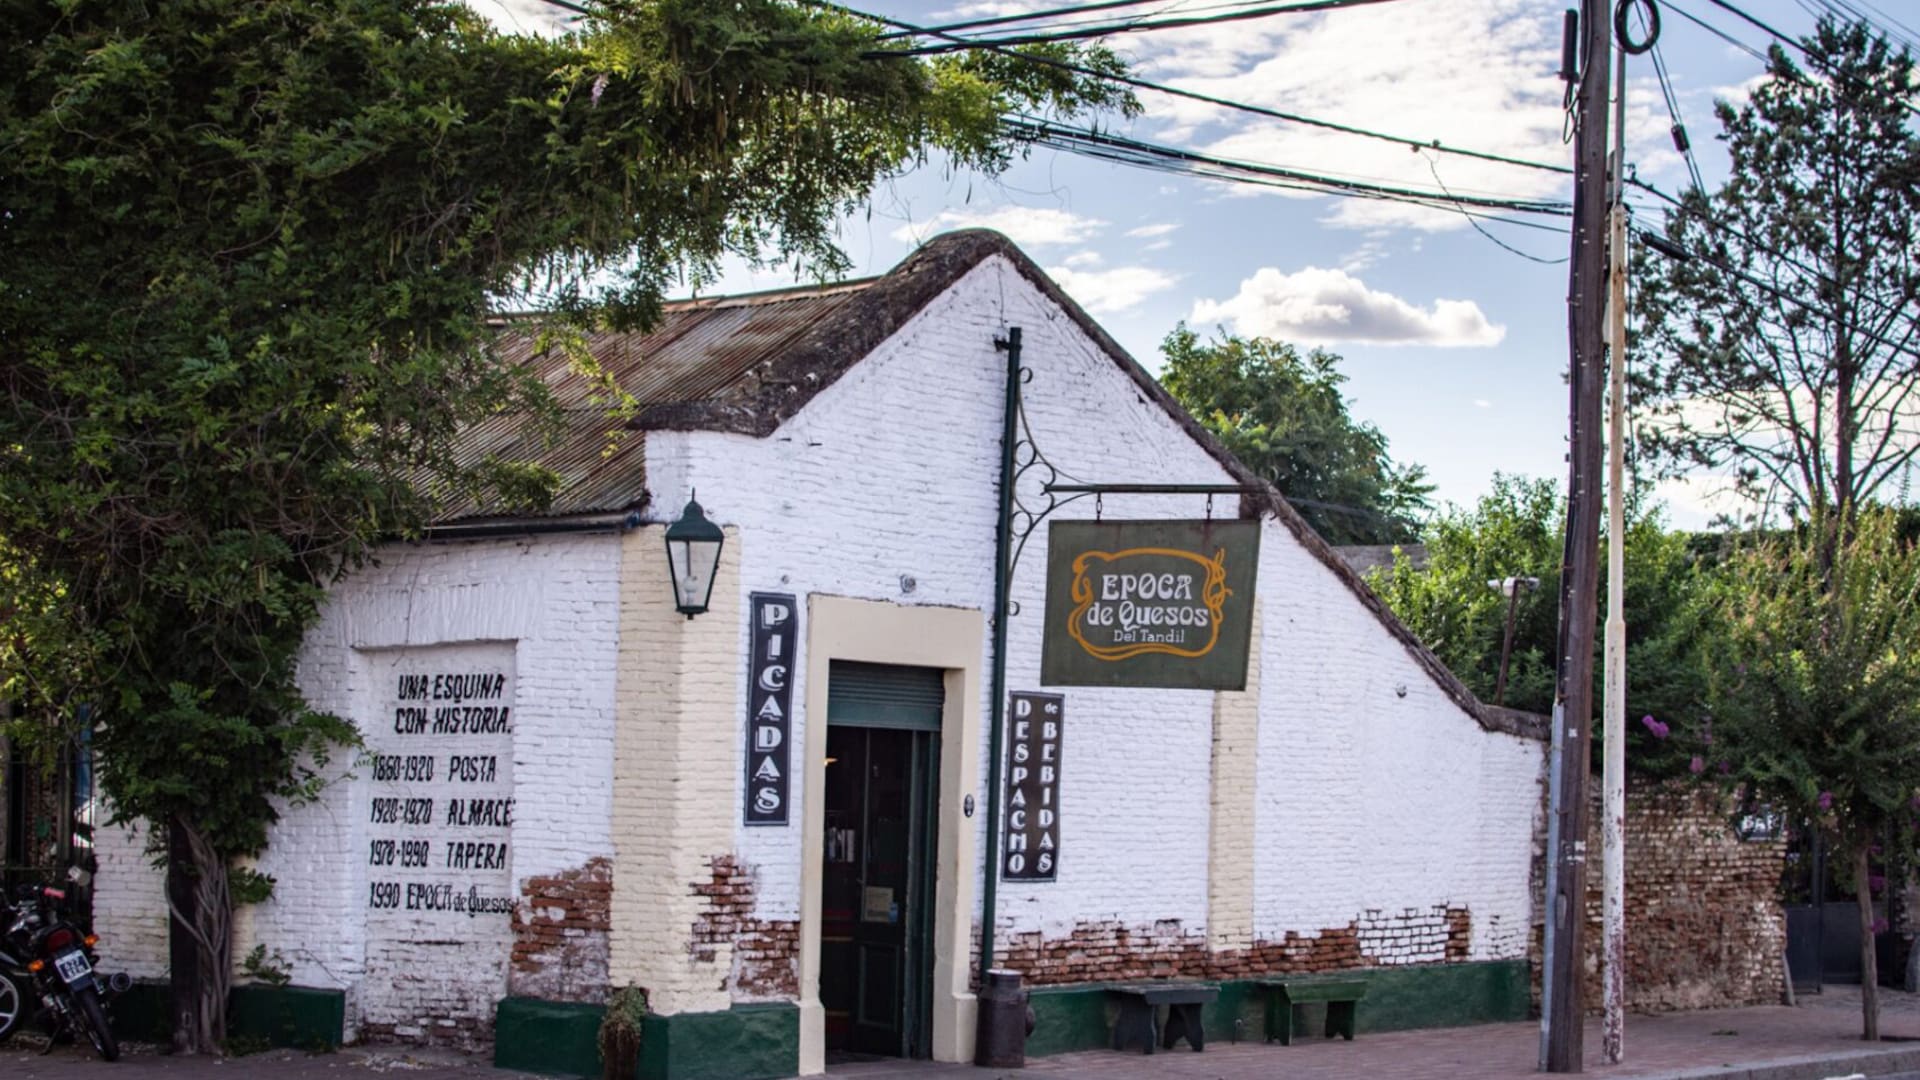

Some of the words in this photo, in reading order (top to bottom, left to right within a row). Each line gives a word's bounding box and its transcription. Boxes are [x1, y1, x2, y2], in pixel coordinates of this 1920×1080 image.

[1101, 572, 1192, 600] EPOCA
[1087, 601, 1114, 625] de
[1118, 601, 1209, 632] Quesos
[1113, 629, 1137, 643] Del
[1140, 629, 1185, 644] Tandil
[398, 674, 429, 700] UNA
[433, 673, 505, 703] ESQUINA
[395, 706, 428, 734] CON
[753, 603, 790, 814] PICADAS
[1044, 701, 1059, 715] de
[447, 755, 497, 783] POSTA
[1008, 698, 1032, 874] DESPACHO
[1037, 721, 1058, 873] BEBIDAS
[446, 841, 507, 871] TAPERA
[369, 881, 401, 909] 1990
[405, 882, 453, 911] EPOCA
[453, 892, 467, 912] de
[467, 885, 514, 918] Quesos
